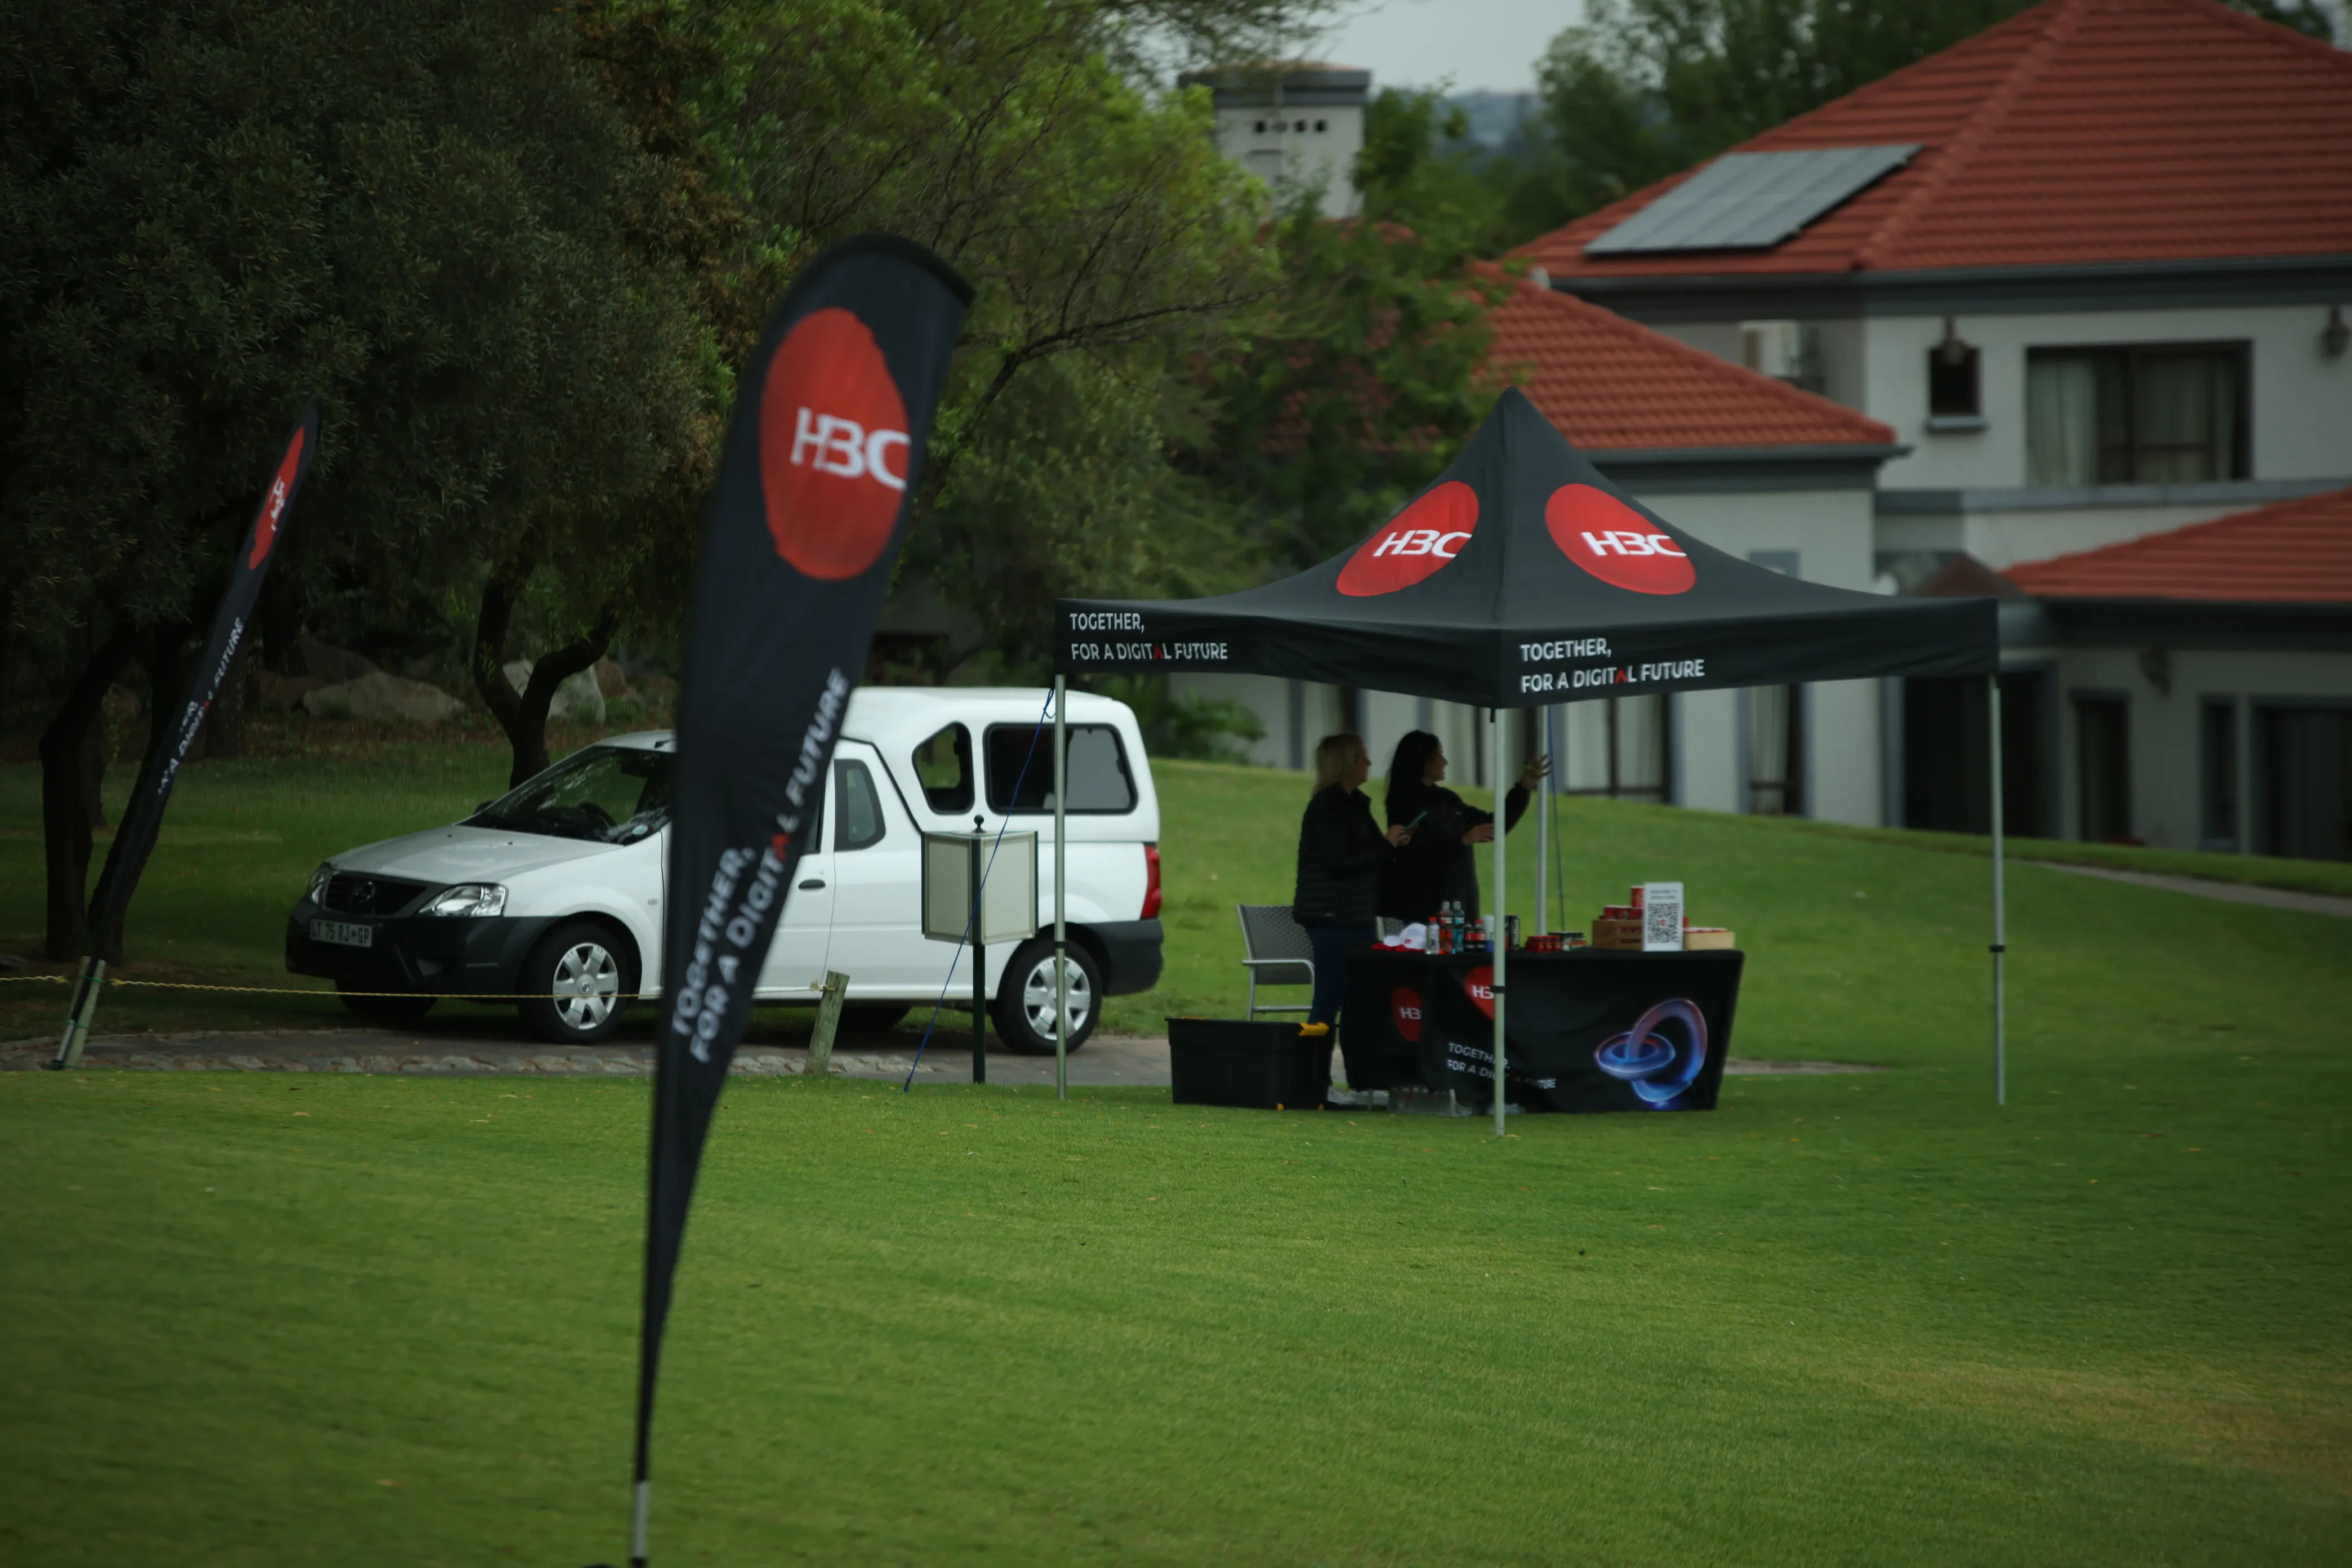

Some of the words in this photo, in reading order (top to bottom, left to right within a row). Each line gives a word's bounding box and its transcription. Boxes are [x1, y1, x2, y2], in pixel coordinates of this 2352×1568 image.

[1373, 529, 1472, 558] H3C
[1580, 530, 1688, 557] H3C
[1070, 612, 1144, 634] TOGETHER,
[1071, 643, 1100, 660] FOR
[1103, 643, 1115, 660] A
[1116, 643, 1171, 660] DIGITAL
[1173, 642, 1228, 660] FUTURE
[1520, 637, 1612, 662] TOGETHER,
[1520, 674, 1554, 693] FOR
[1557, 671, 1570, 689] A
[1571, 665, 1637, 688] DIGITAL
[1640, 658, 1705, 681] FUTURE
[689, 984, 730, 1064] FOR
[718, 955, 741, 985] A
[786, 666, 849, 807] FUTURE
[338, 924, 349, 942] RJ
[358, 926, 369, 945] GP
[671, 847, 756, 1036] TOGETHER,
[1472, 984, 1495, 1000] H3
[1447, 1059, 1466, 1072] FOR
[1467, 1064, 1476, 1075] A
